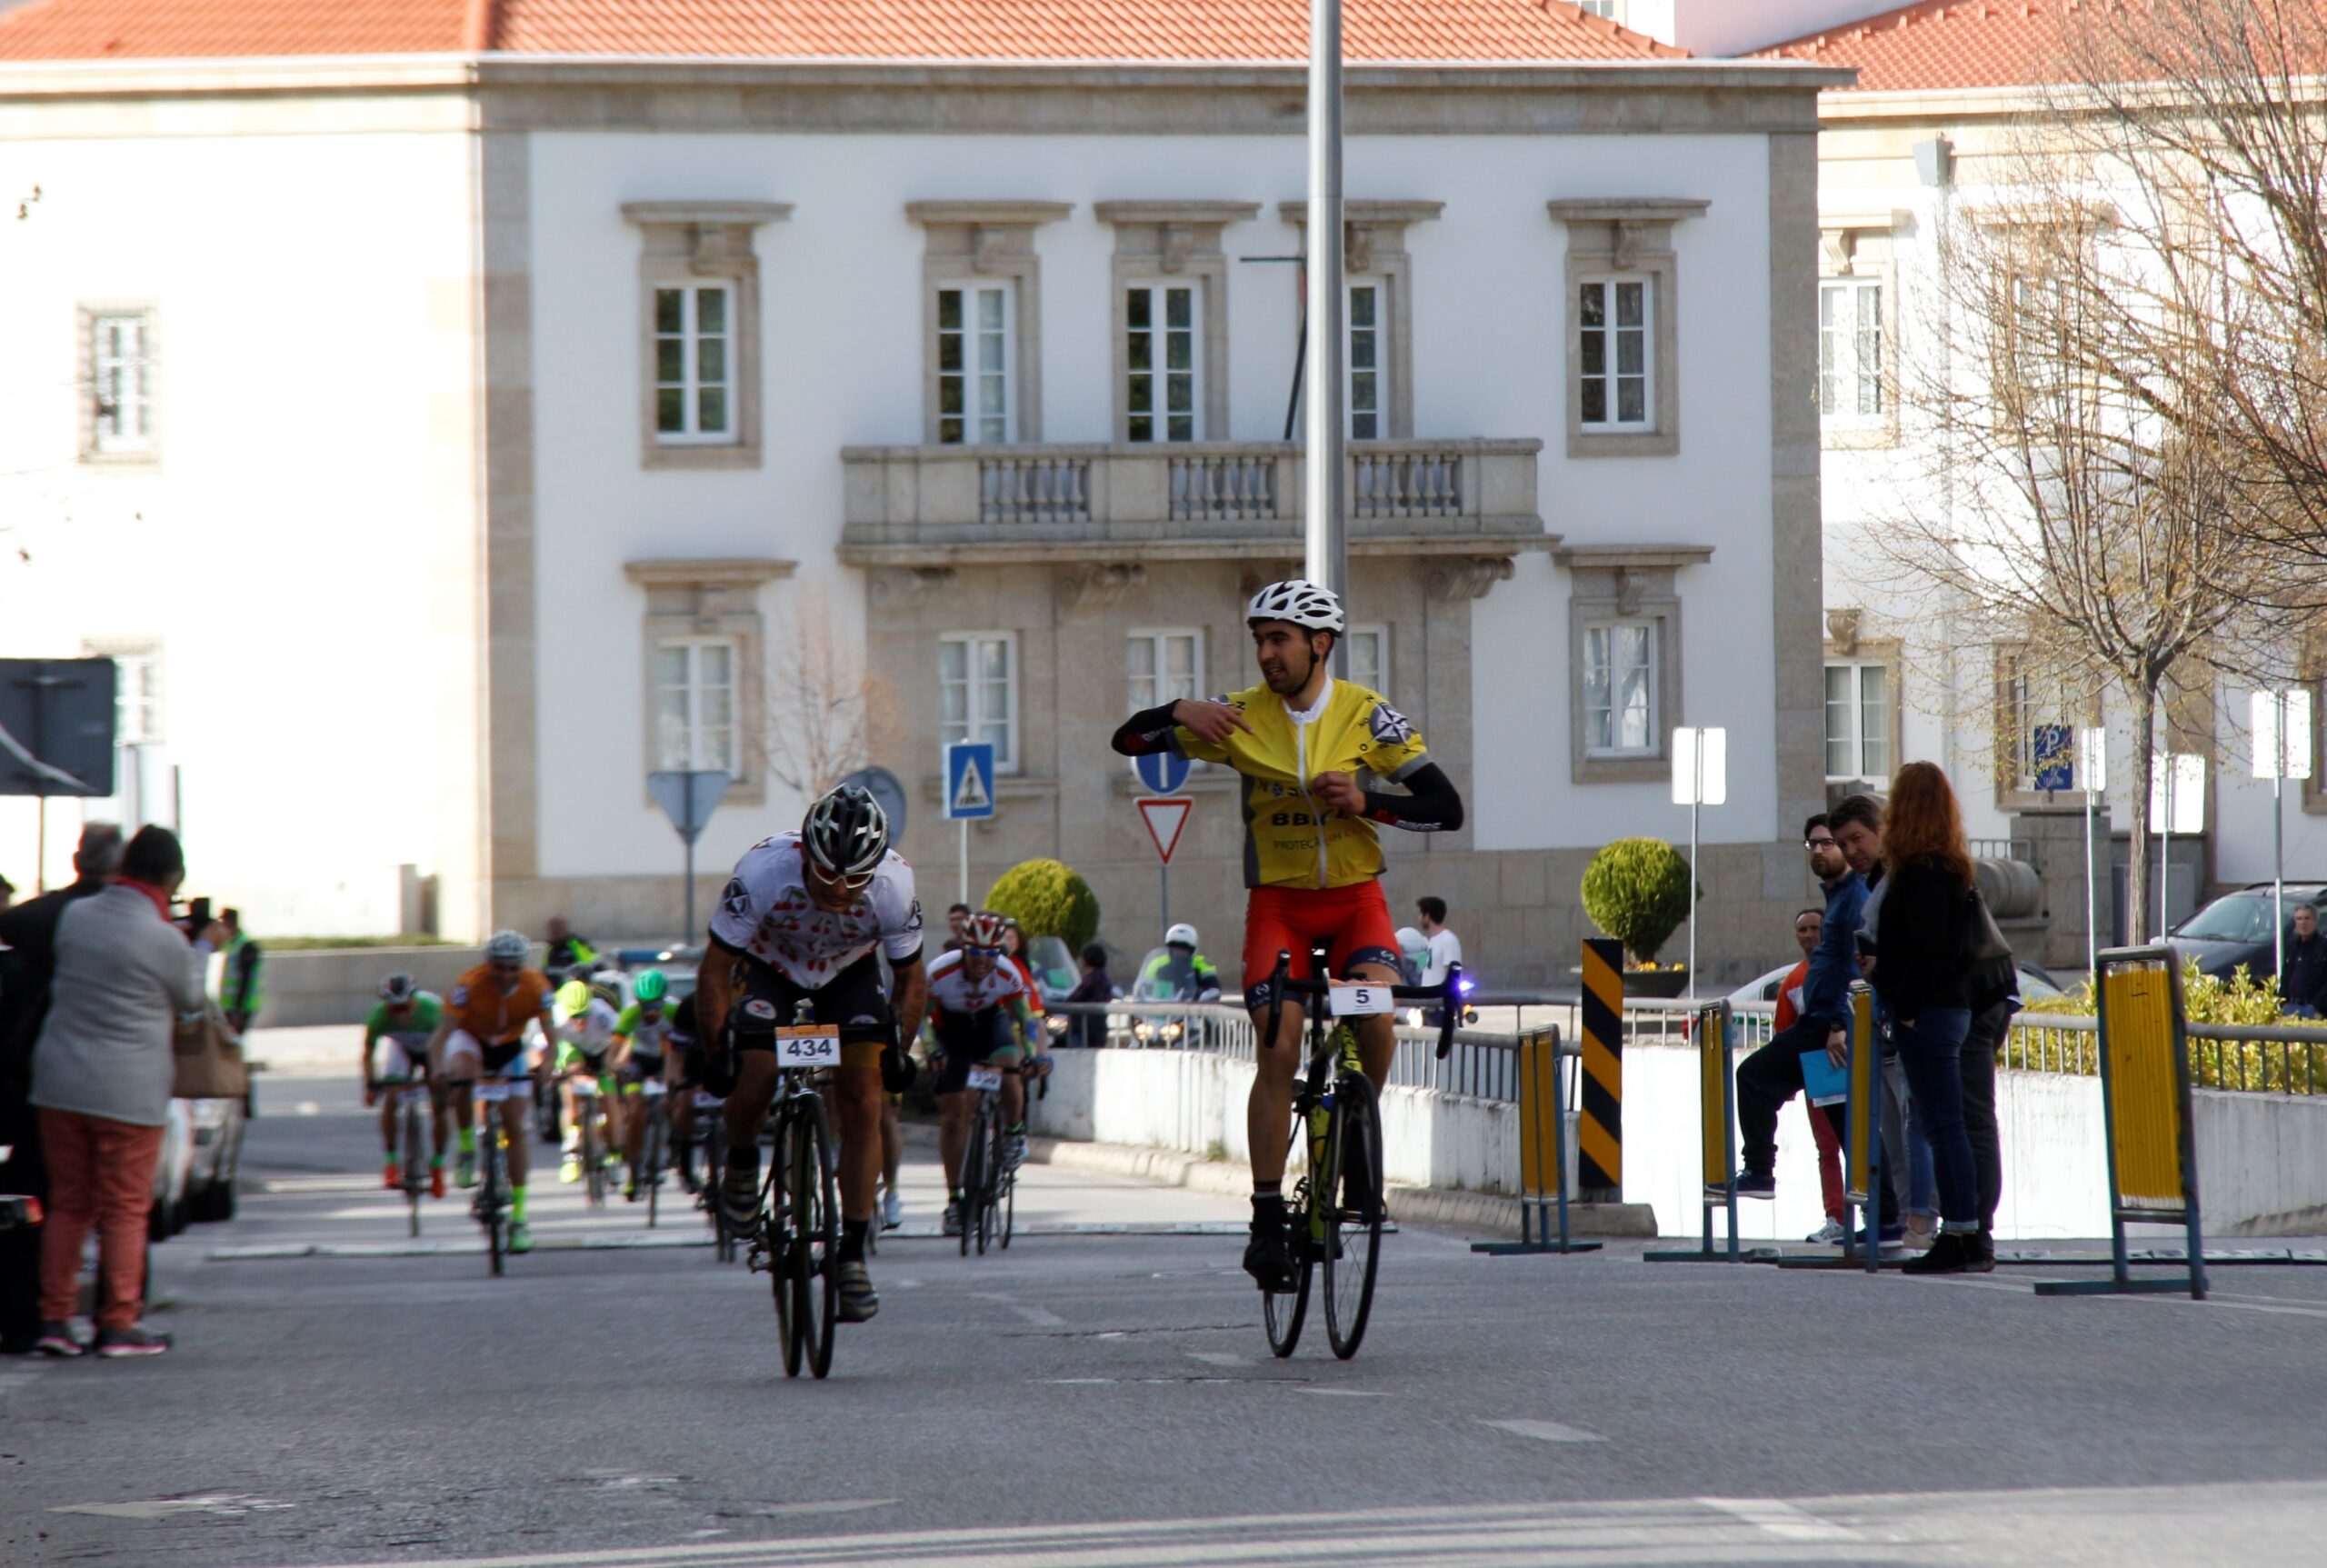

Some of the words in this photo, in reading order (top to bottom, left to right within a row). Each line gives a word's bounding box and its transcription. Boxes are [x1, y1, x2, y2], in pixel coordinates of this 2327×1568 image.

[2046, 730, 2060, 756] P
[1355, 989, 1370, 1004] 5
[786, 1038, 833, 1057] 434
